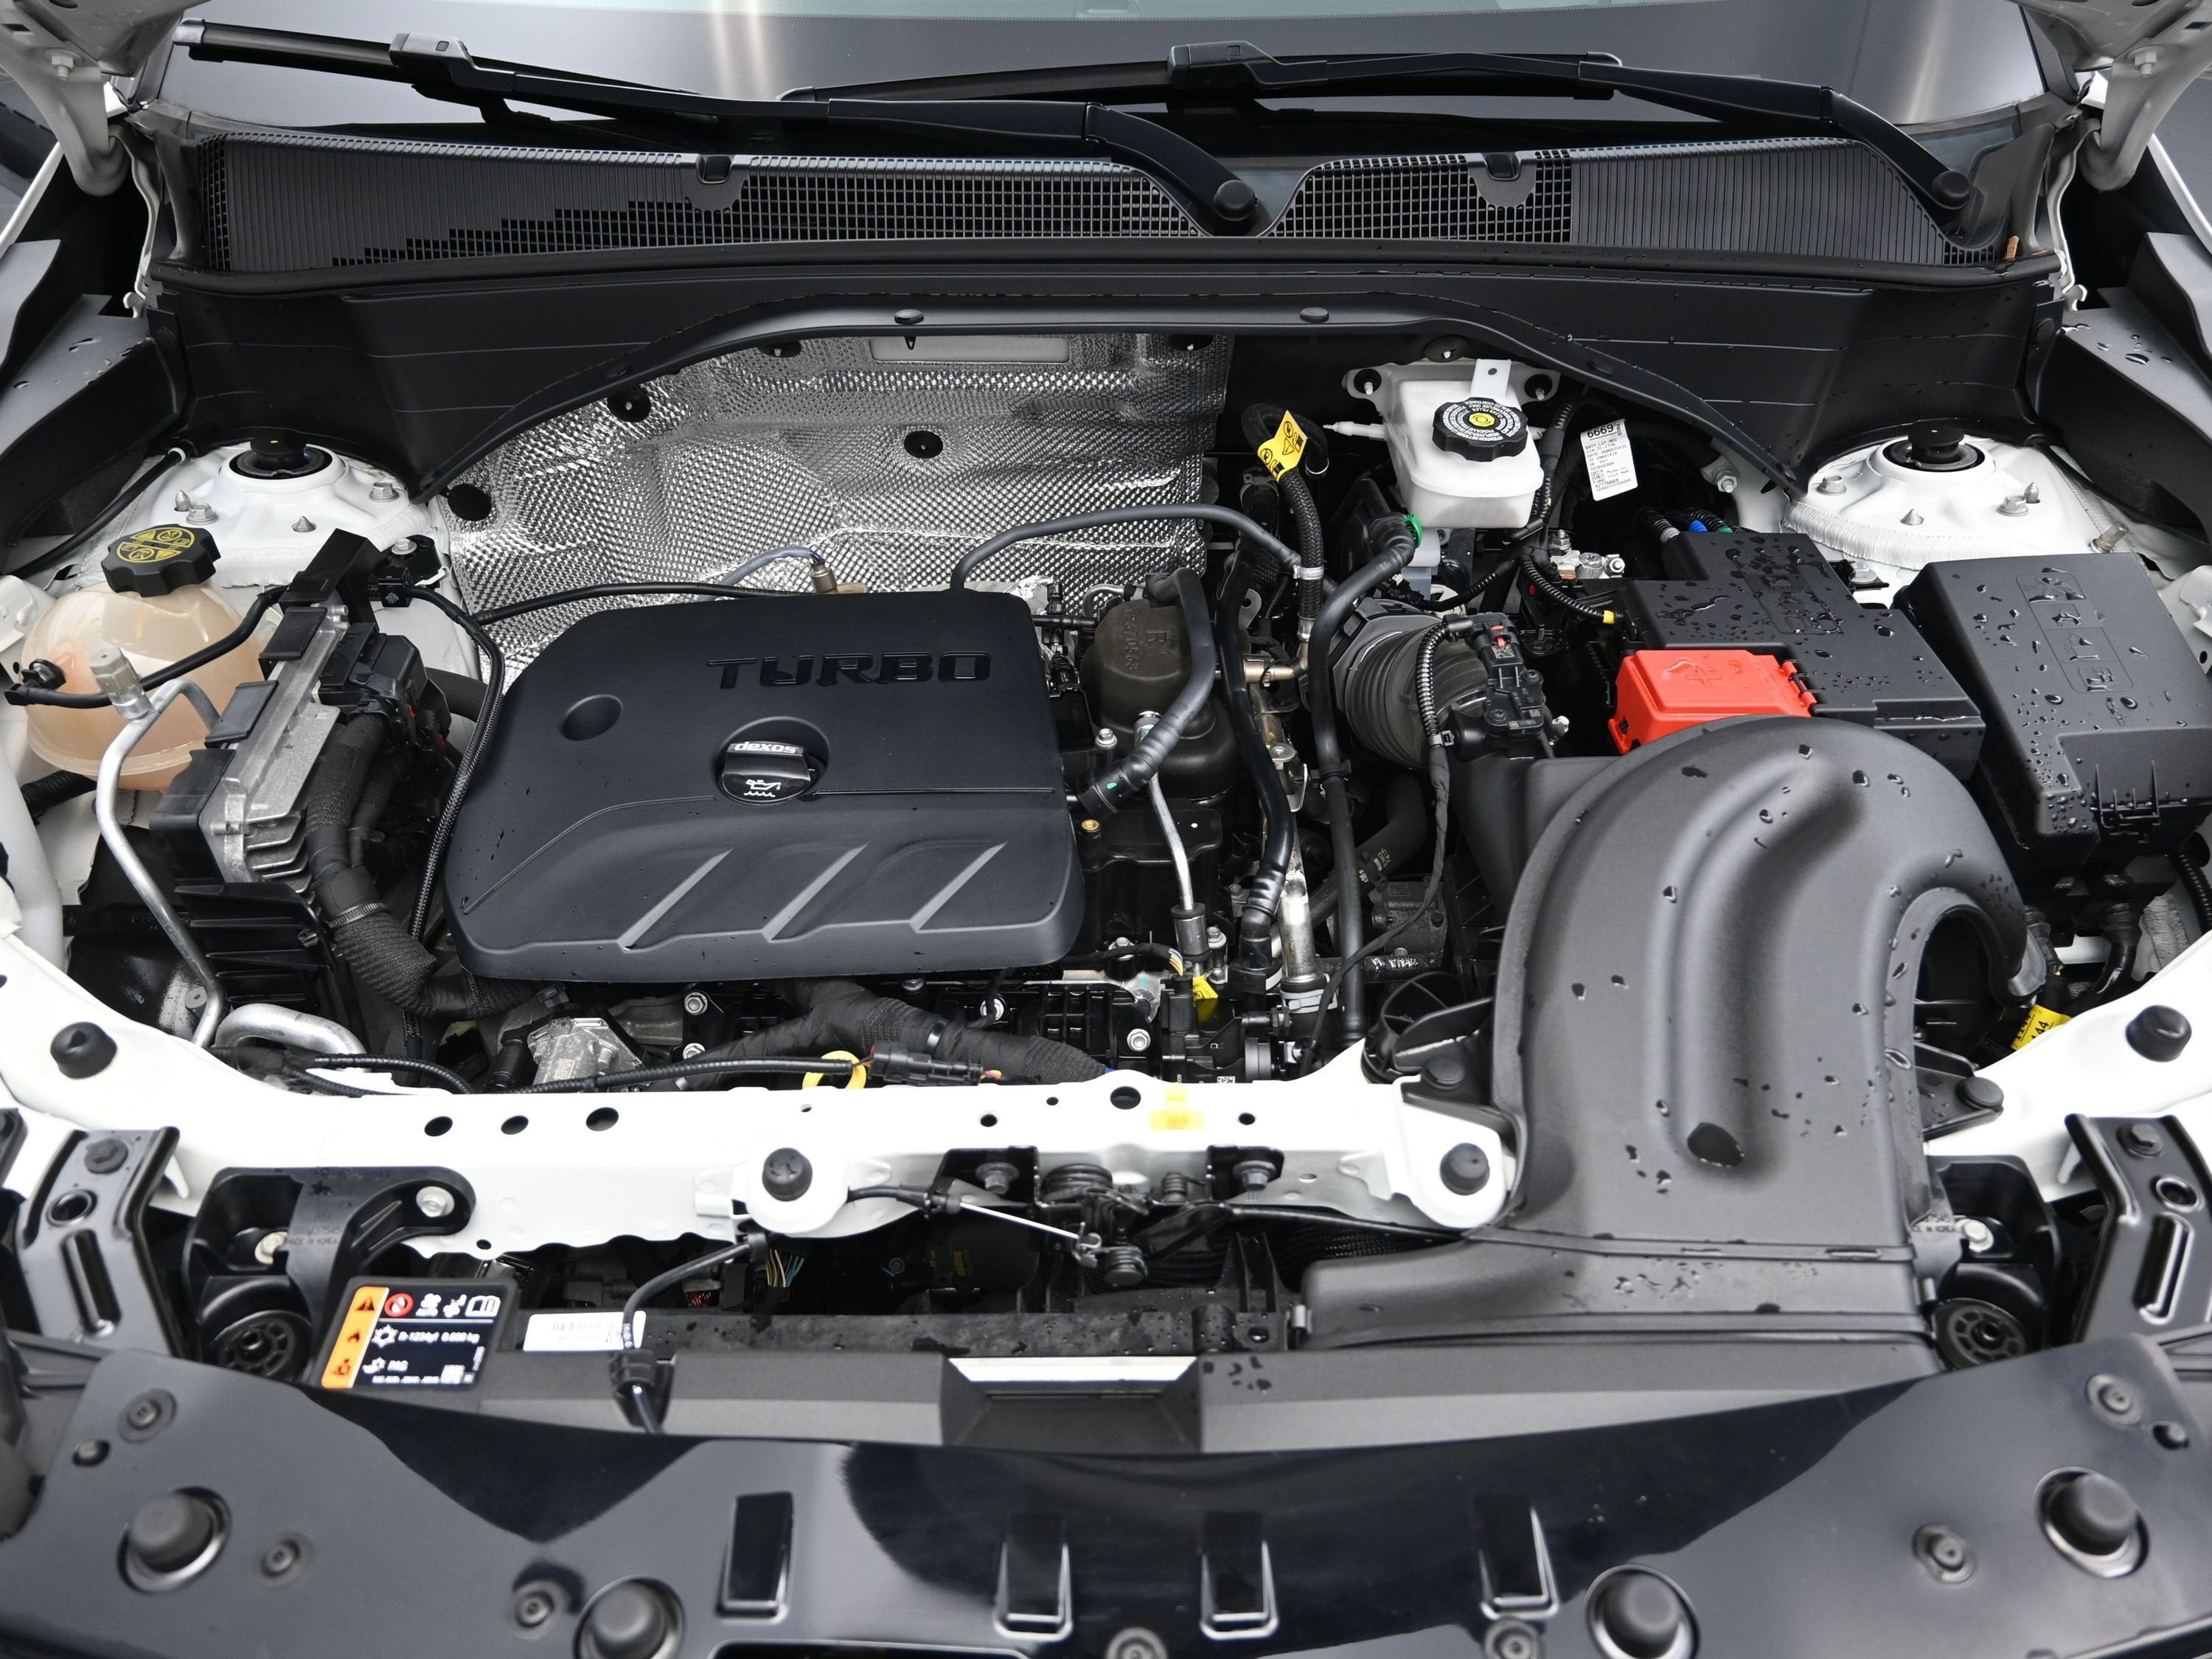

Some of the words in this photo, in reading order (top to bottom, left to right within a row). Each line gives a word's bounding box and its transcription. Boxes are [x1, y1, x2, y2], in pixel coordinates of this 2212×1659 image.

[1587, 423, 1614, 438] 6669
[708, 651, 991, 689] TURBO
[734, 741, 797, 754] dexos
[317, 1237, 338, 1245] KOREA
[415, 1307, 439, 1317] AUTO
